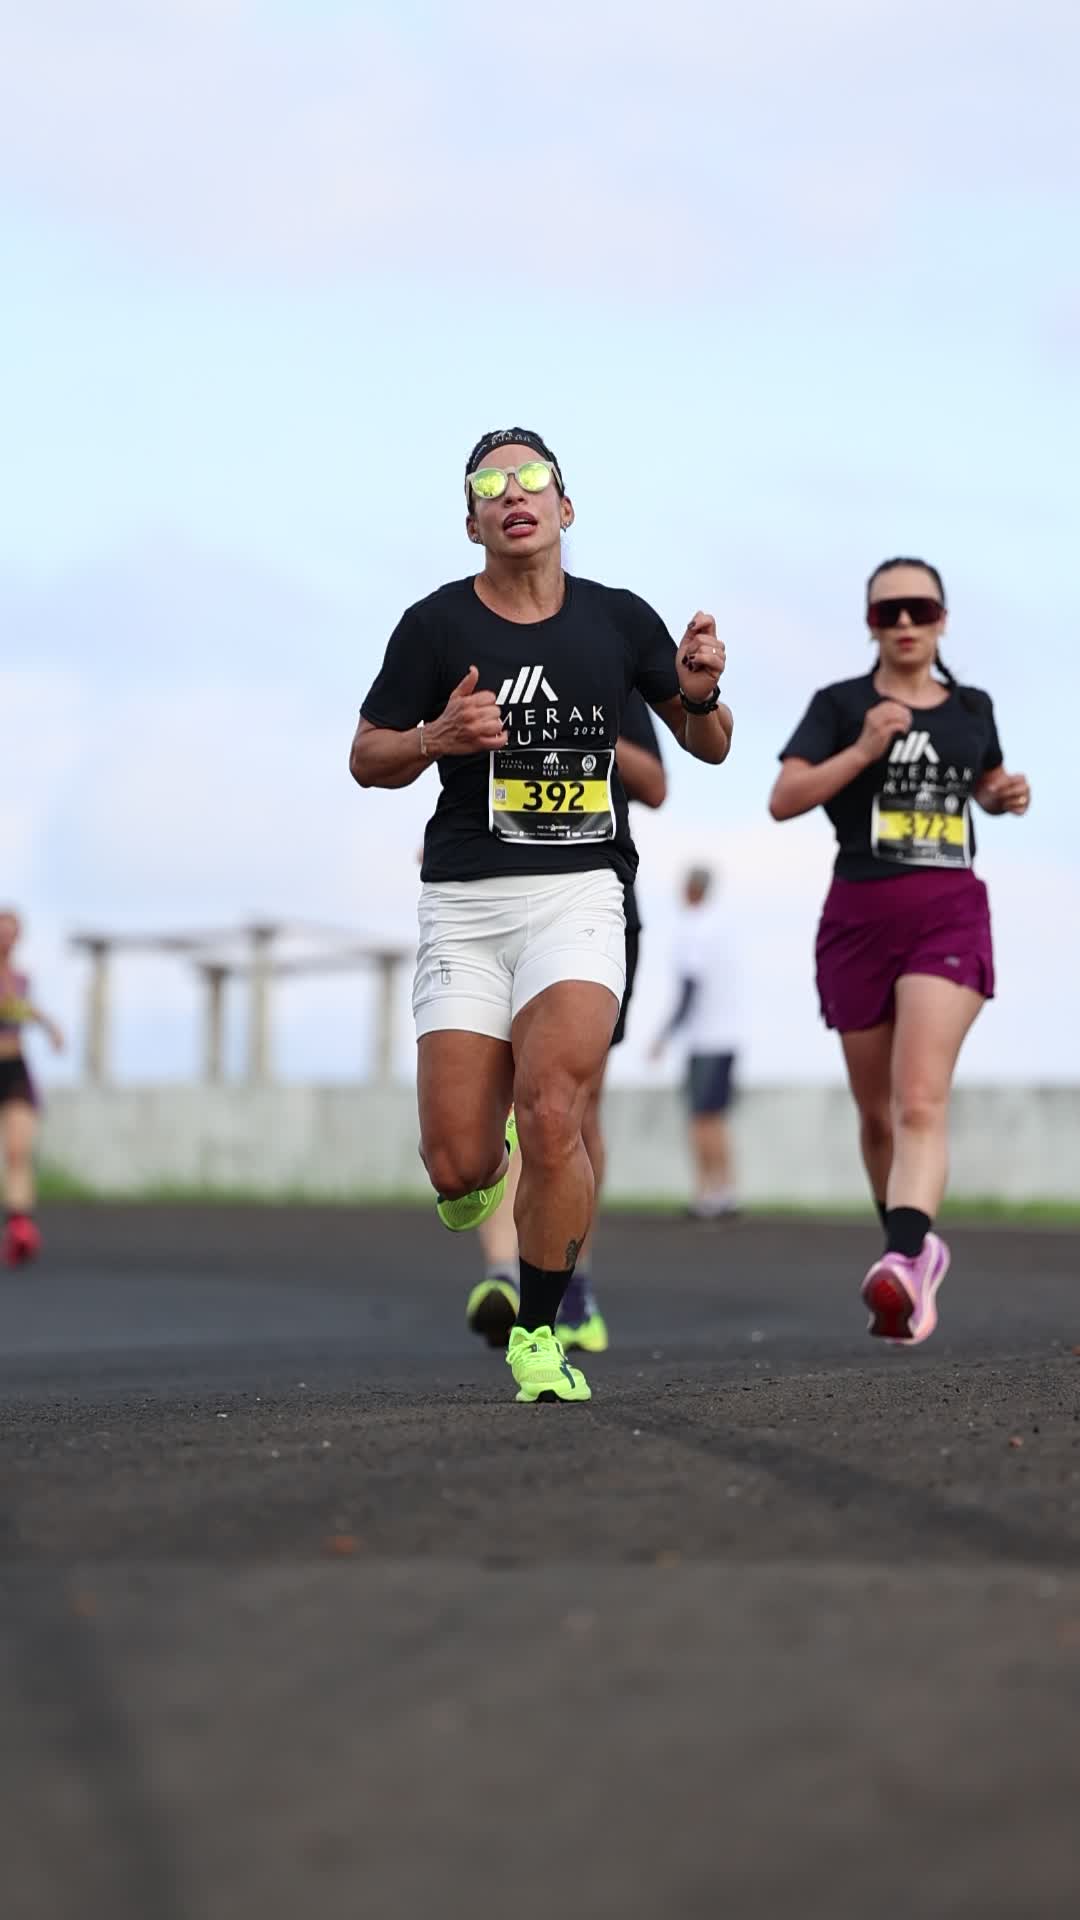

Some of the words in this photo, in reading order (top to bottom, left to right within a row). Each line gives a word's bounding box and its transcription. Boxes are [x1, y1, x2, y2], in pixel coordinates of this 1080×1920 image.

[498, 705, 604, 726] MERAK
[504, 728, 557, 746] UN
[574, 727, 604, 736] 2026
[522, 781, 585, 812] 392
